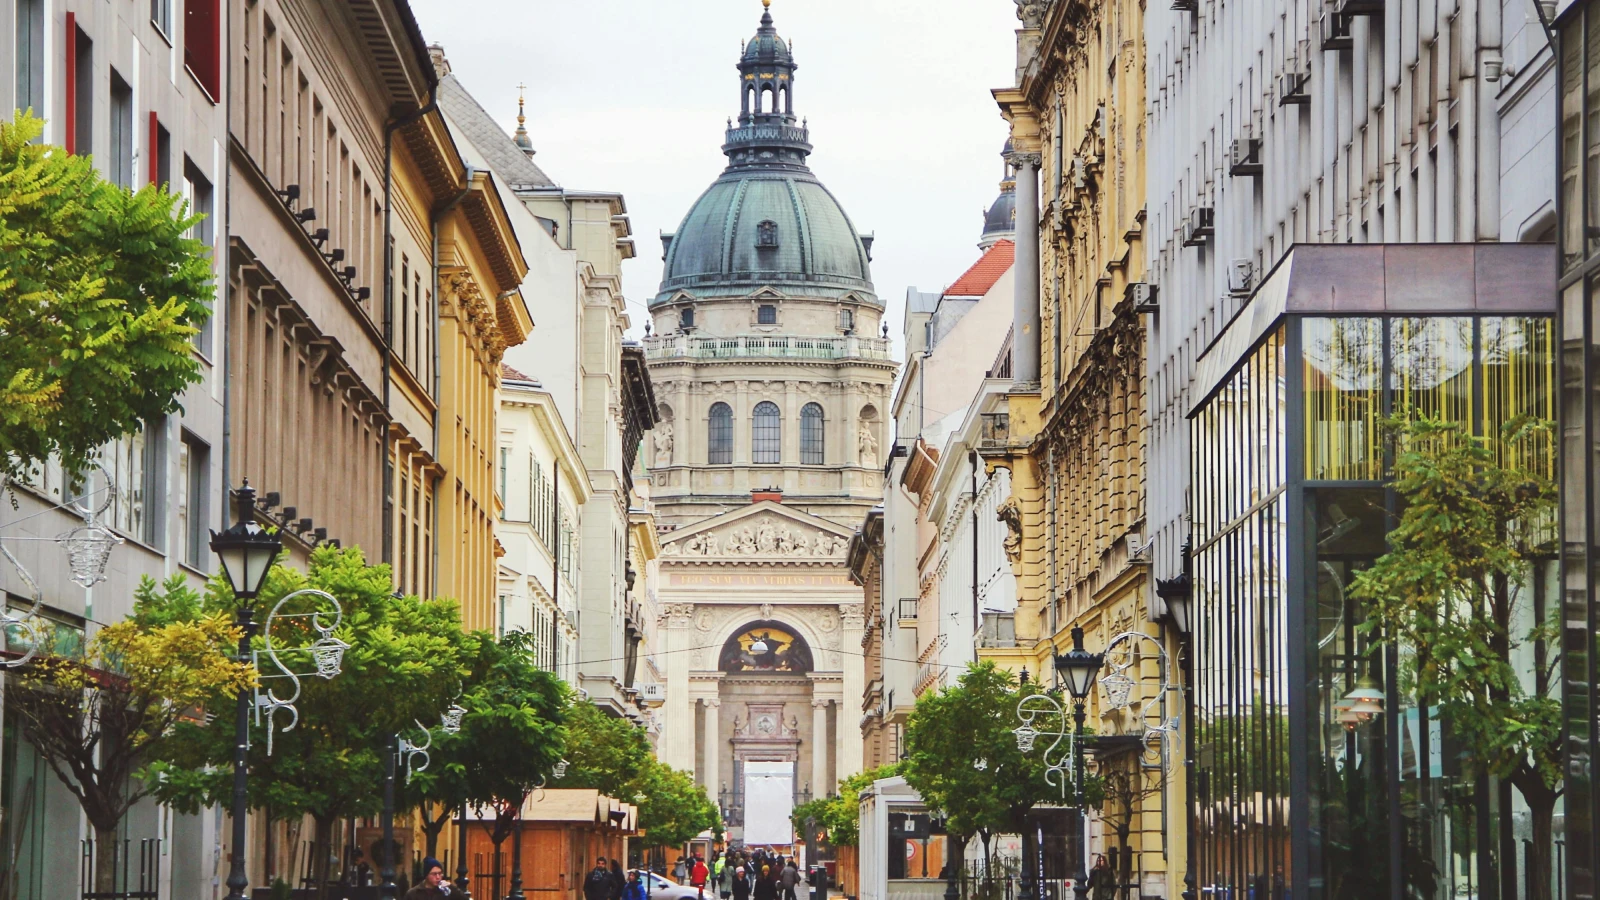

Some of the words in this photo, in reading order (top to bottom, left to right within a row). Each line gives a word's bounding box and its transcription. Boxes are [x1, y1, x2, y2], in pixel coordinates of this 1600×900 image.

[708, 575, 732, 585] SUM
[739, 575, 758, 585] VIA
[763, 575, 806, 585] VERITAS
